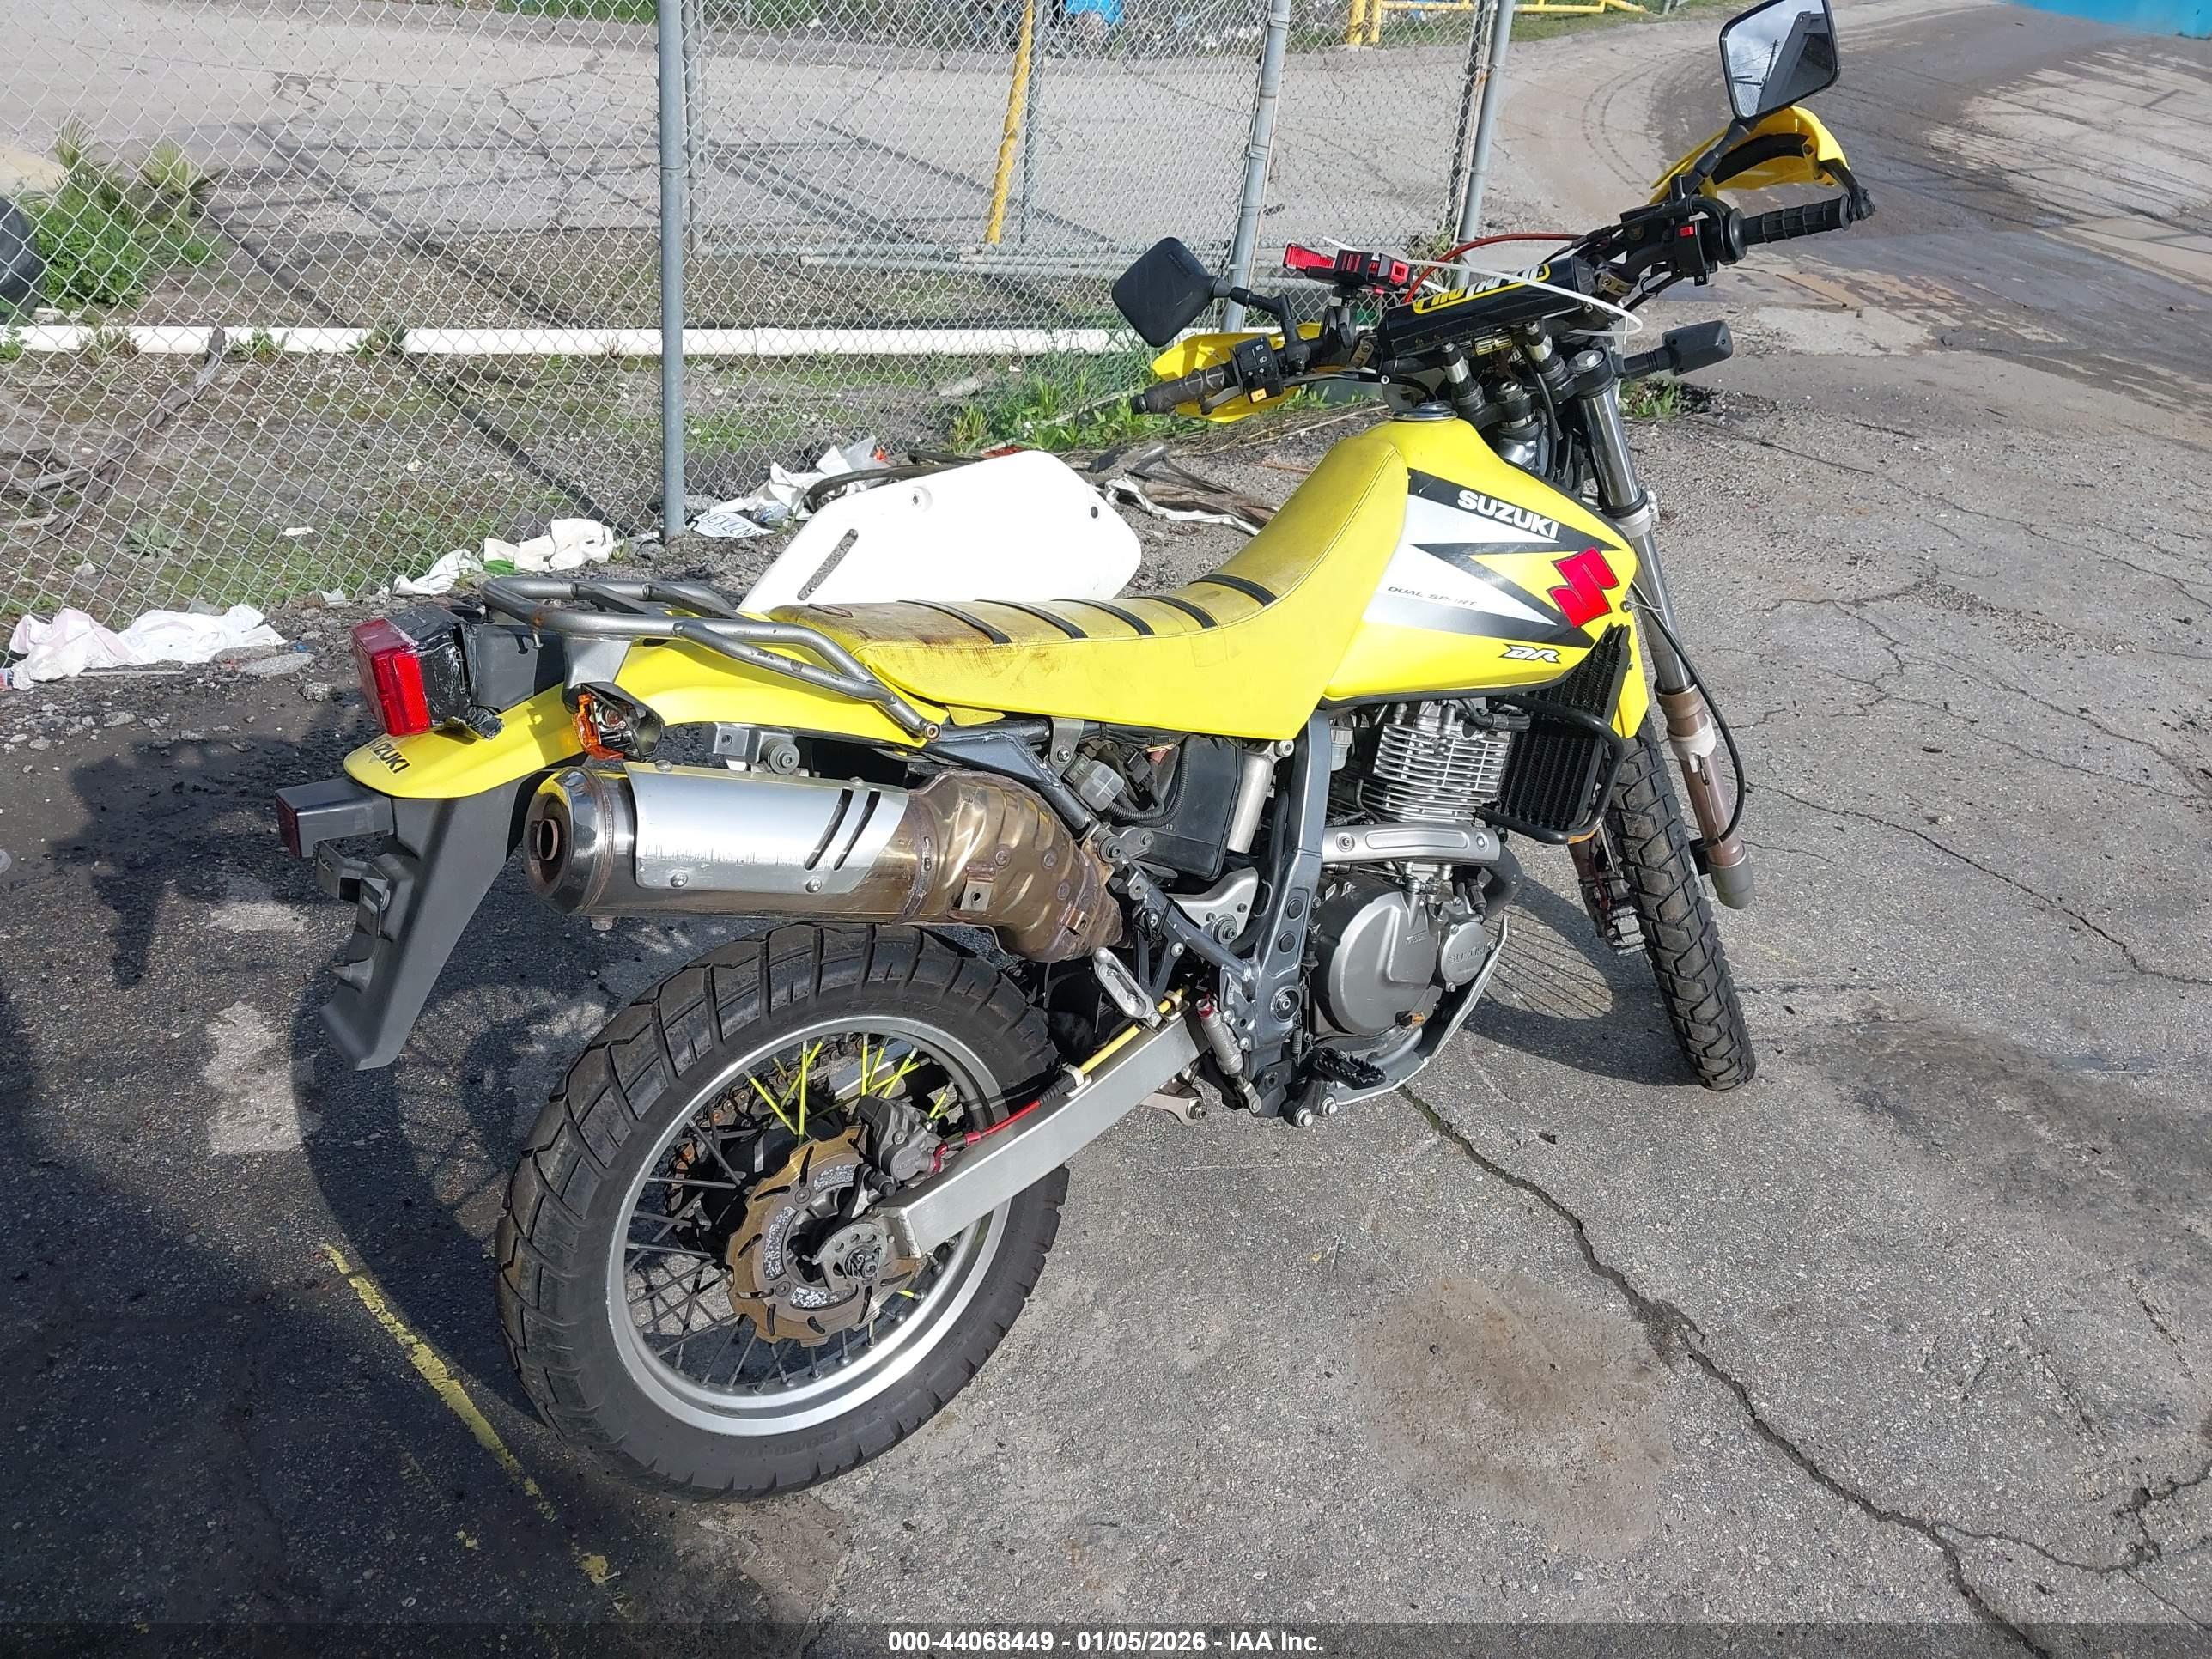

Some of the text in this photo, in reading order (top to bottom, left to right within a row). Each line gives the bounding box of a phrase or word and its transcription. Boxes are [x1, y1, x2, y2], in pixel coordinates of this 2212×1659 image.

[1457, 489, 1559, 539] SUZUKI
[1388, 586, 1423, 597] DUAL
[1498, 643, 1562, 664] DR
